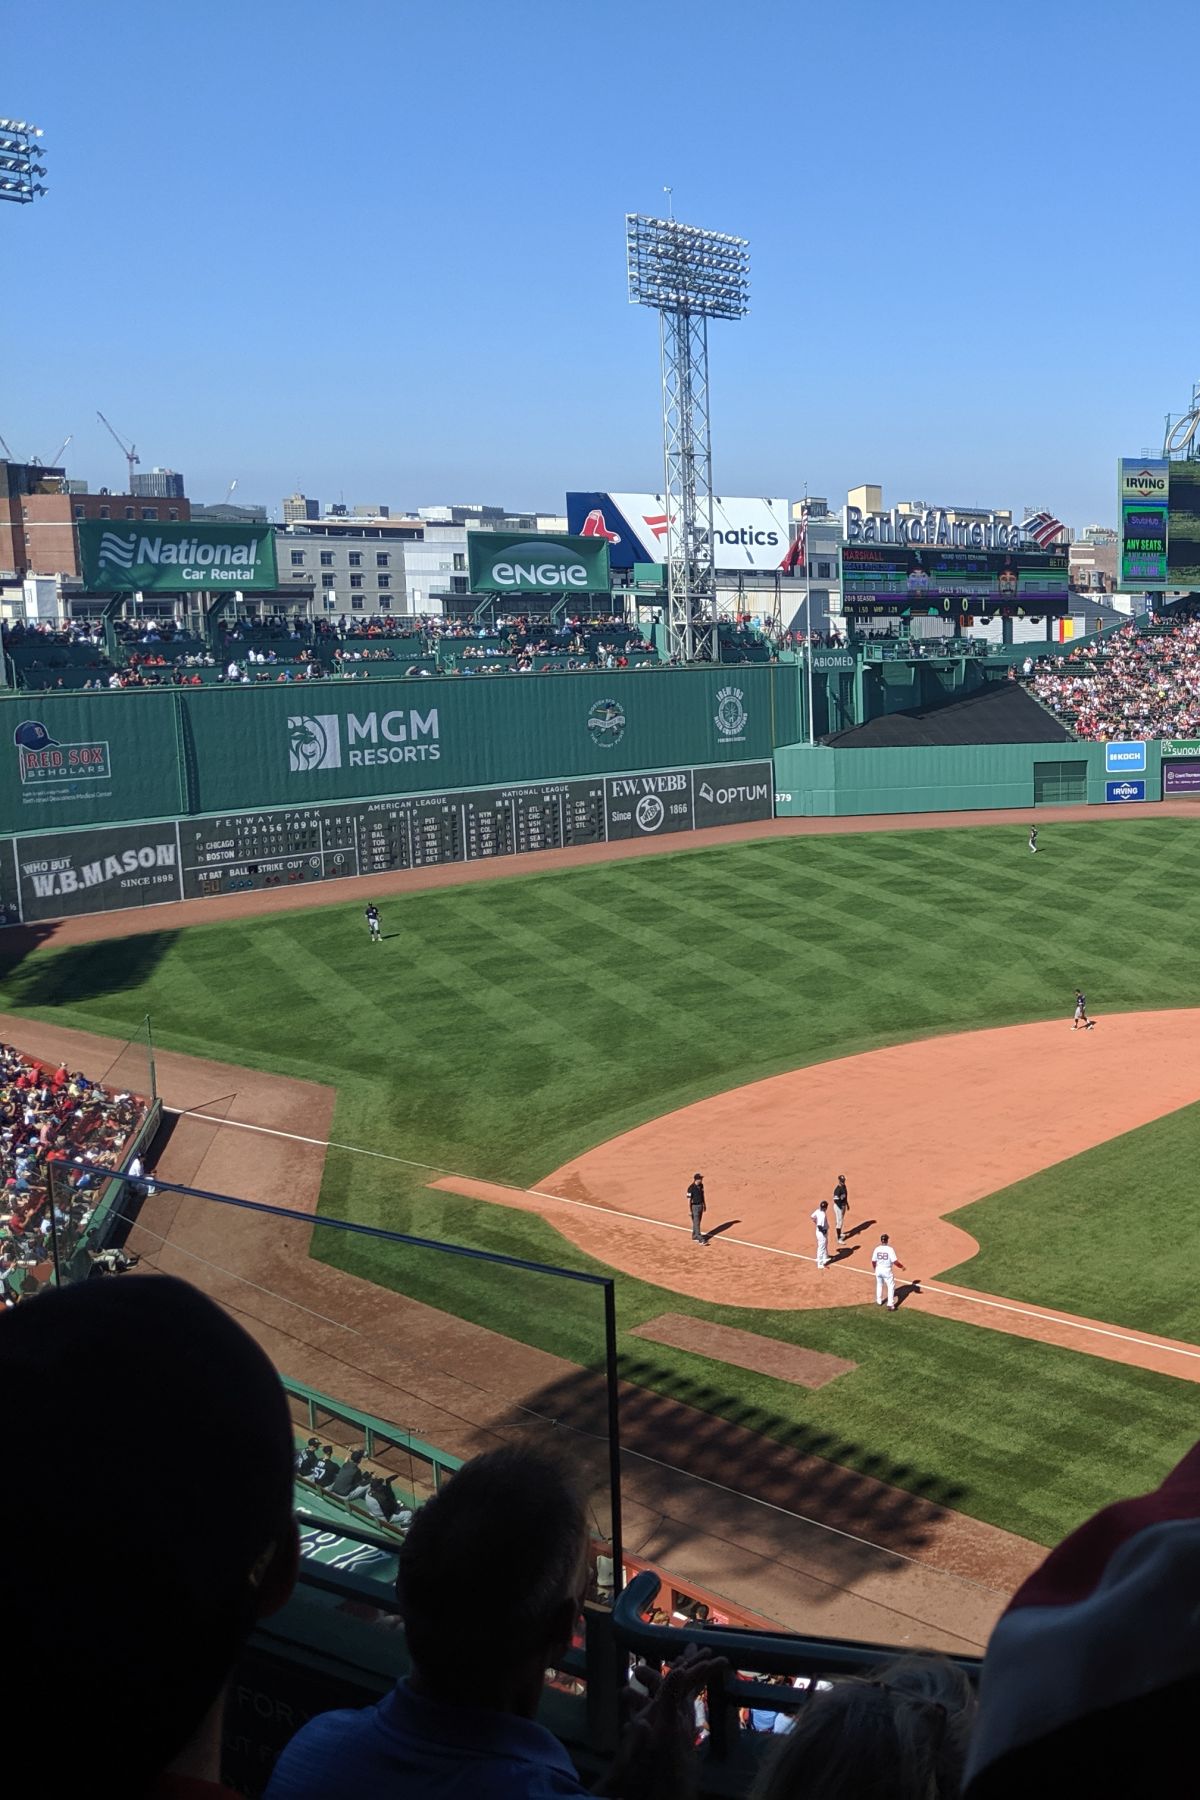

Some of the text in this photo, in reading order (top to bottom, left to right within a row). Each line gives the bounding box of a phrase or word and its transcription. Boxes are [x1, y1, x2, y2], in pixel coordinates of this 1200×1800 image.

[1126, 478, 1165, 489] IRVING
[843, 505, 1021, 548] Bank of America
[1126, 539, 1139, 549] ANY
[844, 550, 884, 561] MARSHALL
[1049, 559, 1068, 567] BETTS
[182, 568, 255, 580] Car Rental
[943, 598, 968, 612] 0 0
[813, 655, 853, 669] ABIOMED
[348, 708, 440, 744] MGM
[26, 748, 104, 769] RED SOX
[350, 744, 441, 766] RESORTS
[27, 765, 105, 778] SCHOLARS
[641, 774, 687, 793] WEBB
[502, 785, 569, 798] NATIONAL LEAGUE
[716, 784, 767, 804] OPTUM
[1113, 787, 1138, 796] IRVING
[368, 797, 447, 812] AMERICAN LEAGUE
[669, 803, 688, 815] 1866
[216, 810, 320, 828] FENWAY PARK
[612, 811, 632, 822] Since
[371, 830, 384, 838] BAL
[206, 840, 235, 850] CHICAGO
[206, 850, 235, 860] BOSTON
[23, 859, 72, 875] WHO BUT
[257, 863, 284, 873] STRIKE
[286, 860, 303, 869] OUT
[120, 873, 174, 888] SINCE 1898
[198, 871, 223, 881] AT BAT
[314, 1467, 326, 1480] 57
